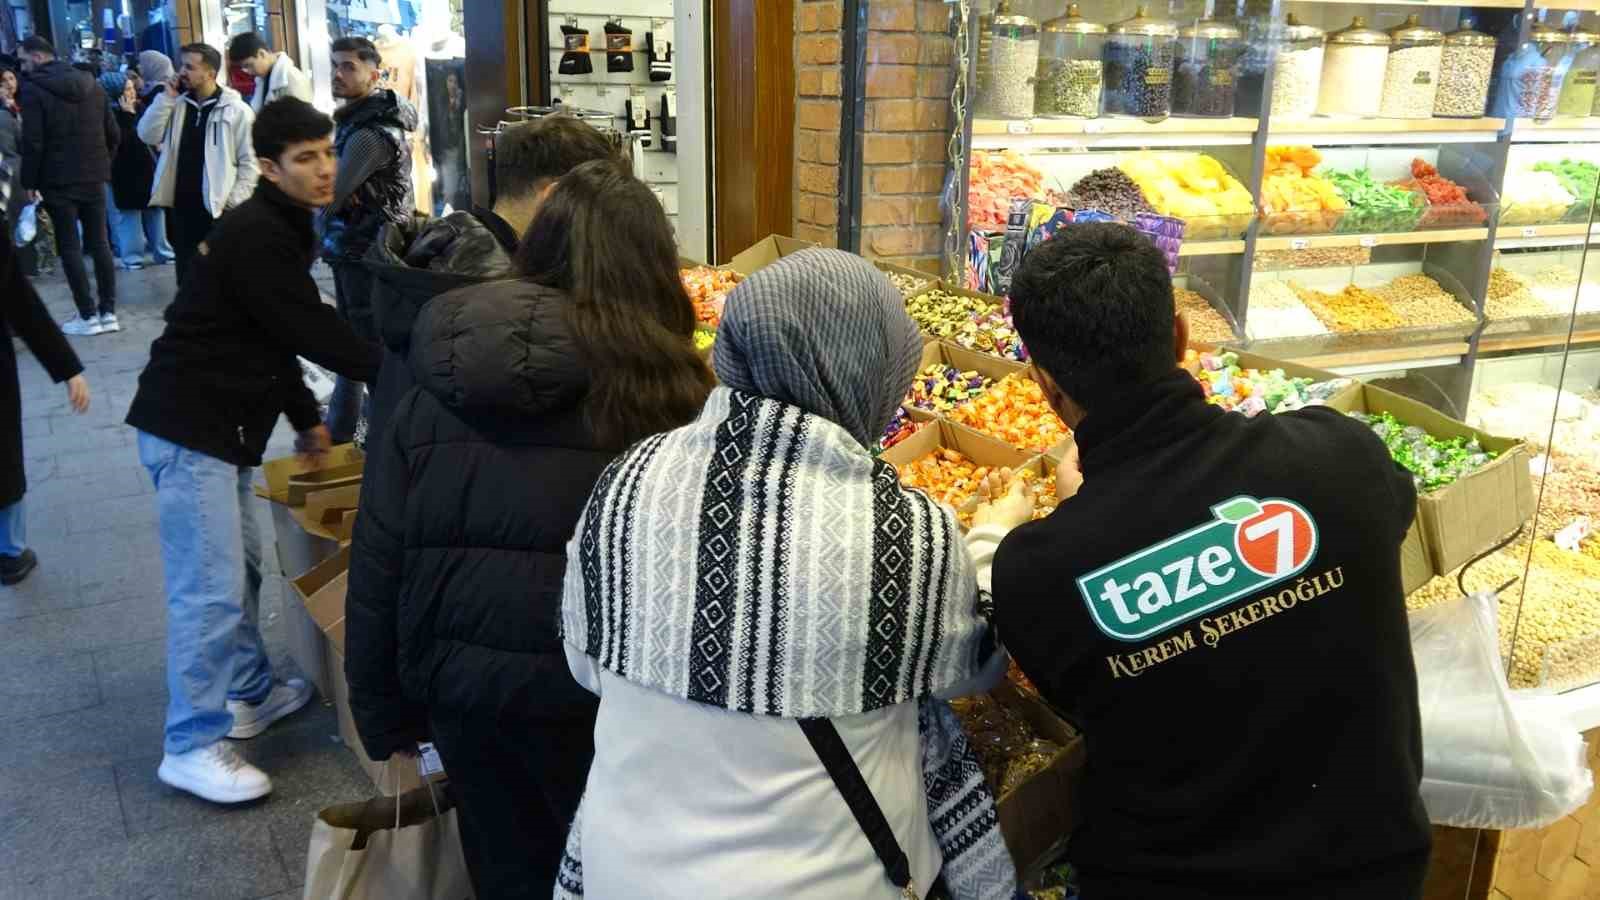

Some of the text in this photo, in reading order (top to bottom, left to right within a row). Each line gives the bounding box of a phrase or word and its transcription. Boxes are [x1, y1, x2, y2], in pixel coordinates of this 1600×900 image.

[1100, 511, 1295, 624] taze 7
[1106, 566, 1345, 679] KEREM ŞEKEROĞLU
